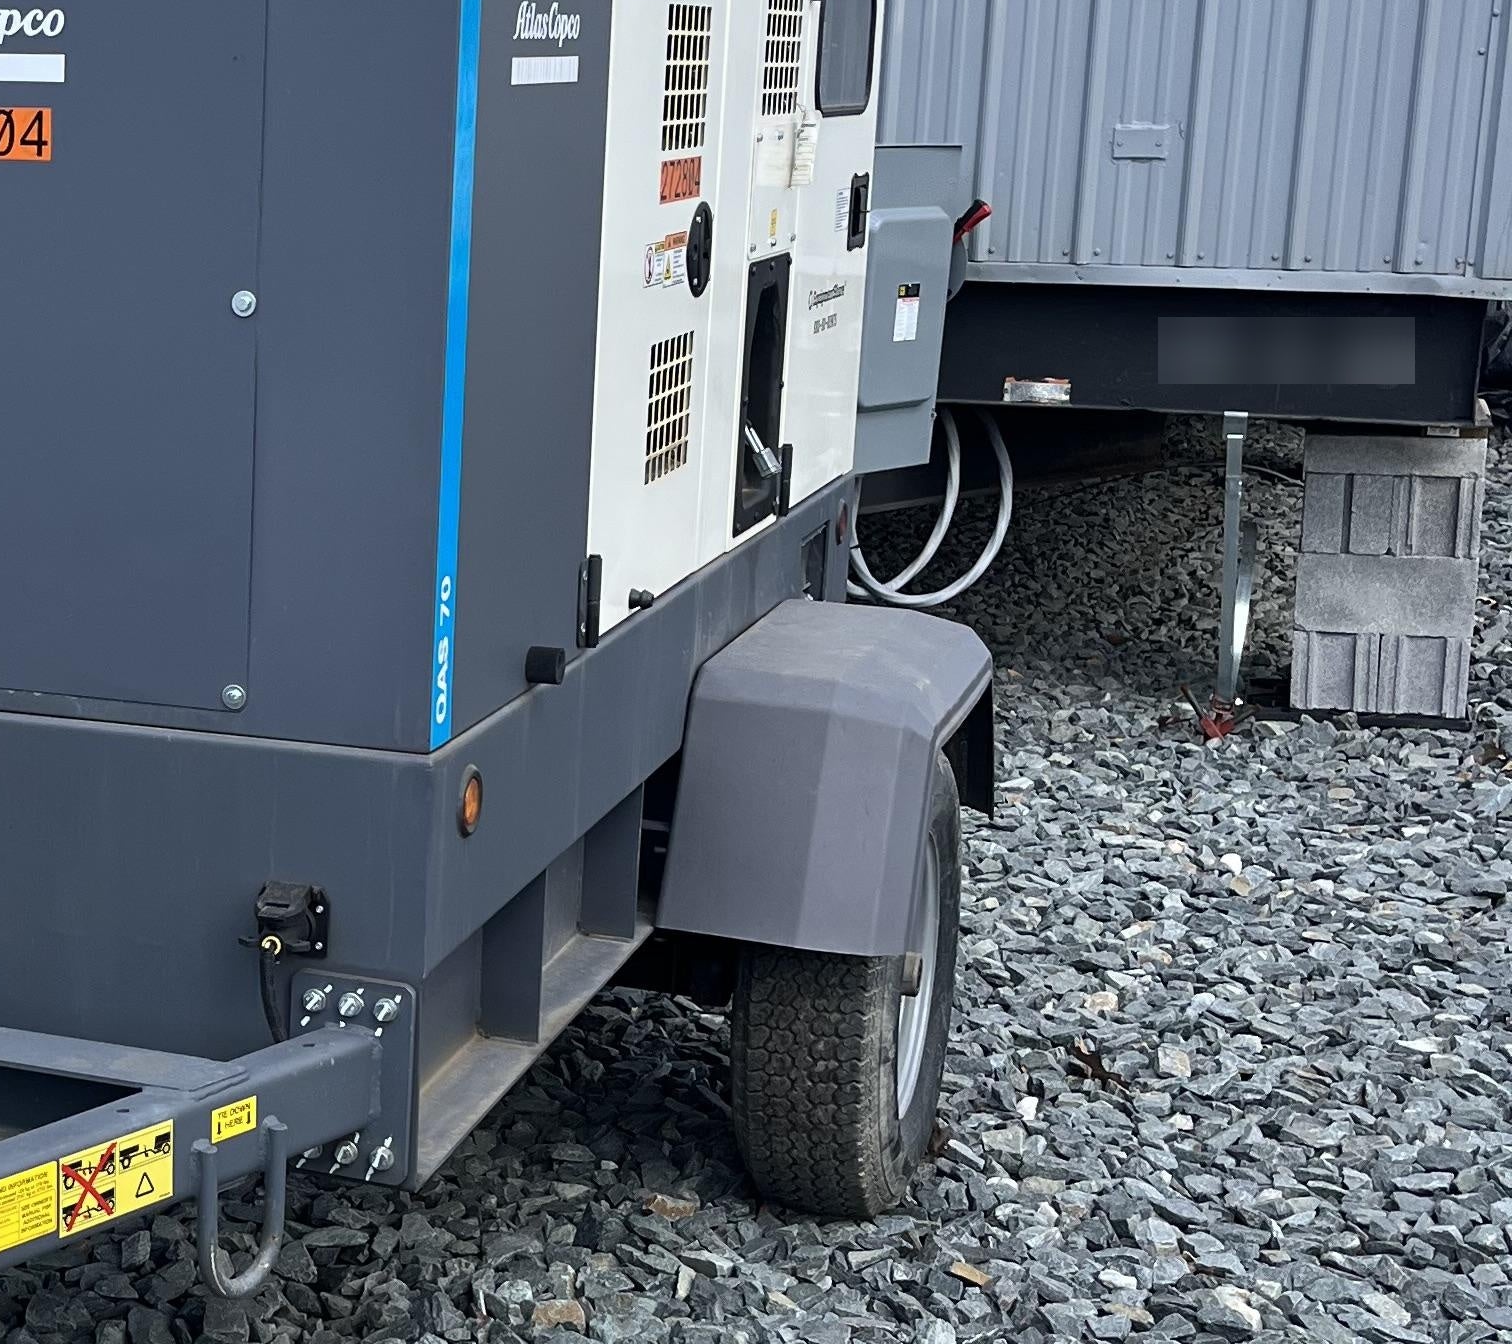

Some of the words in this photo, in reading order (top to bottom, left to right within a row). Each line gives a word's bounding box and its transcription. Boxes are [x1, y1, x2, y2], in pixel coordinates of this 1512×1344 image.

[512, 0, 548, 40] Atlas
[548, 2, 581, 47] Copco
[660, 157, 702, 202] 272804
[439, 575, 451, 627] 70
